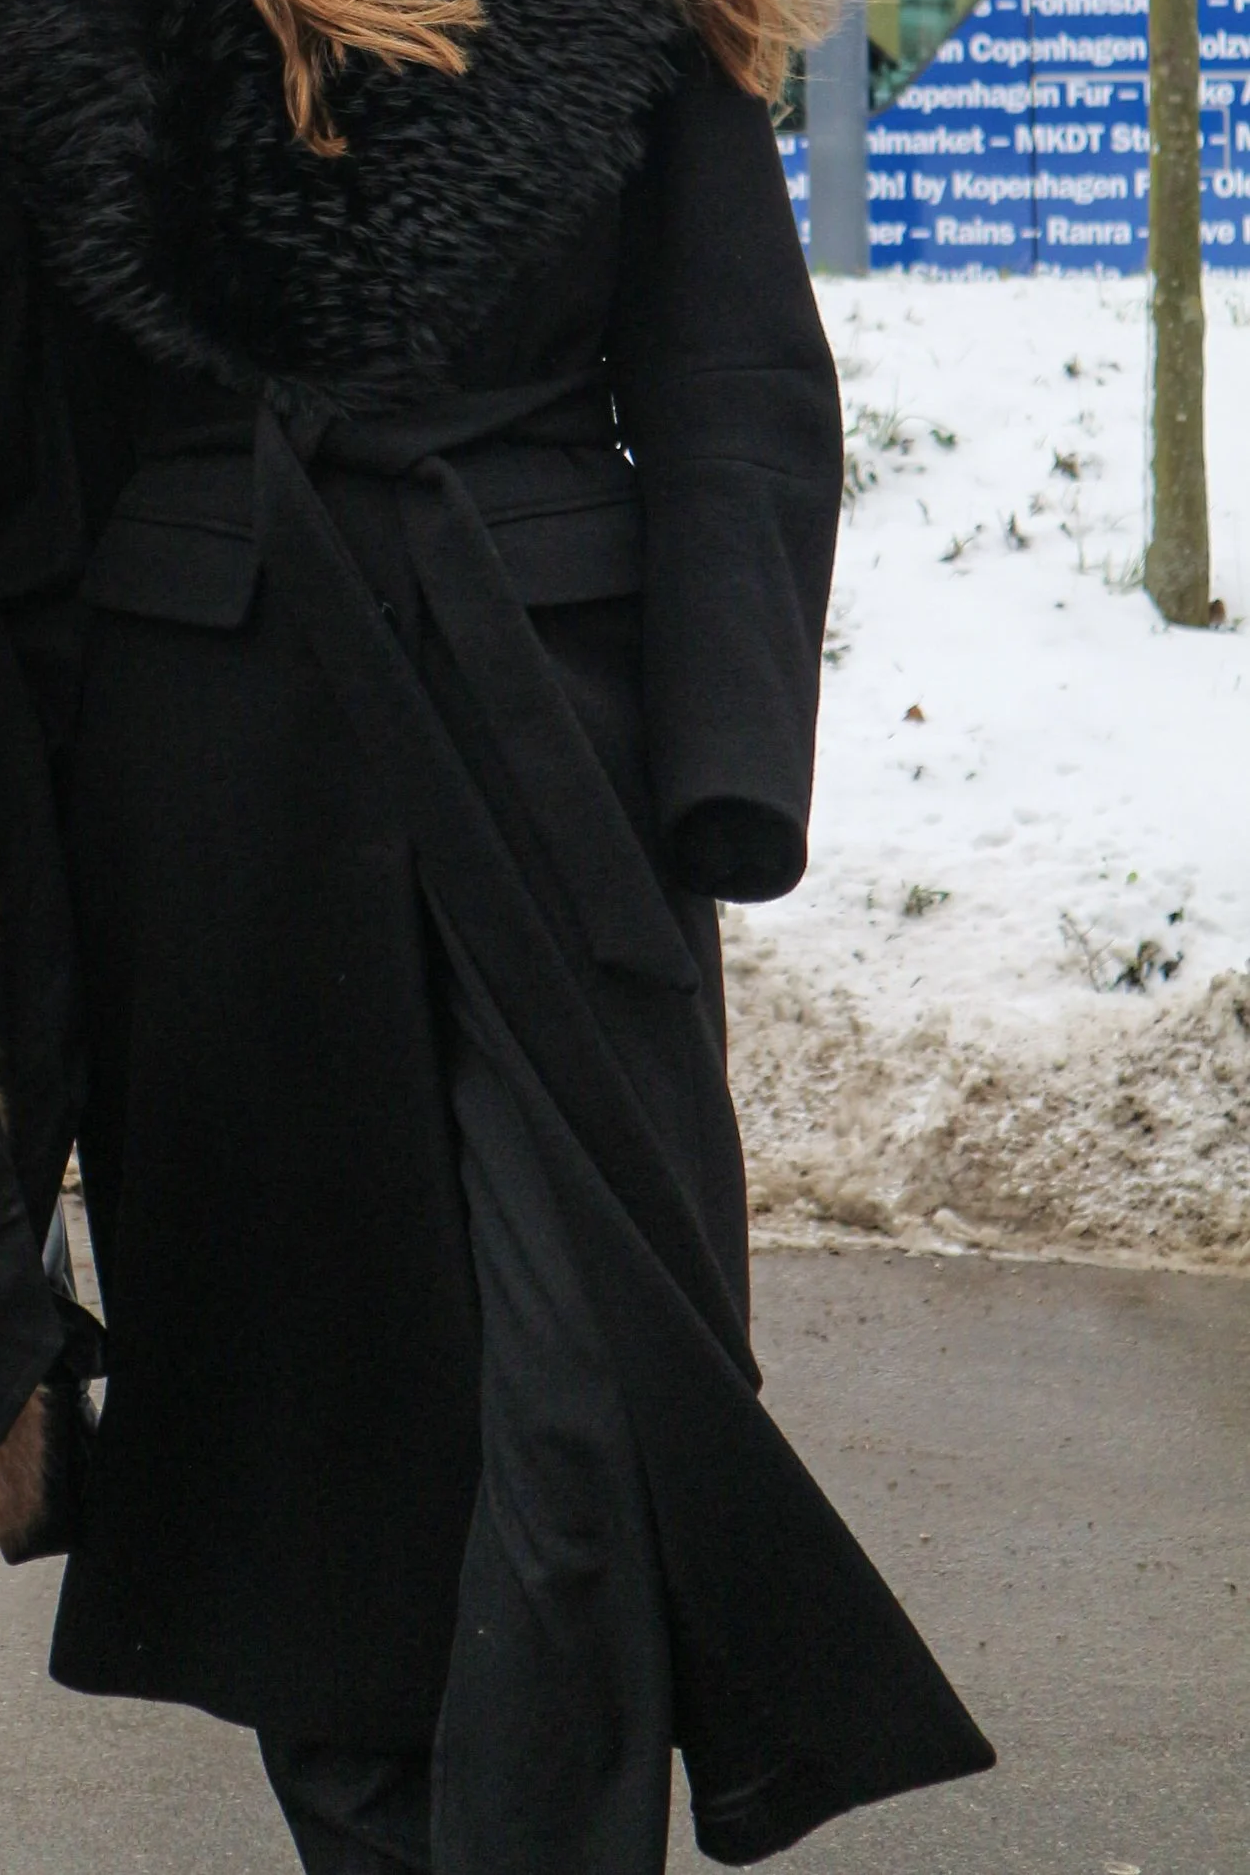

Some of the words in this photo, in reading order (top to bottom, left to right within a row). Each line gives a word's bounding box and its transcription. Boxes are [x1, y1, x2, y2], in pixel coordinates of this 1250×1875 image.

[969, 31, 1148, 68] Copenhagen
[1065, 77, 1114, 108] Fur
[1014, 123, 1105, 154] MKDT
[912, 172, 947, 205] by
[952, 170, 1129, 206] Kopenhagen
[935, 216, 1016, 246] Rains
[1046, 215, 1133, 246] Ranra
